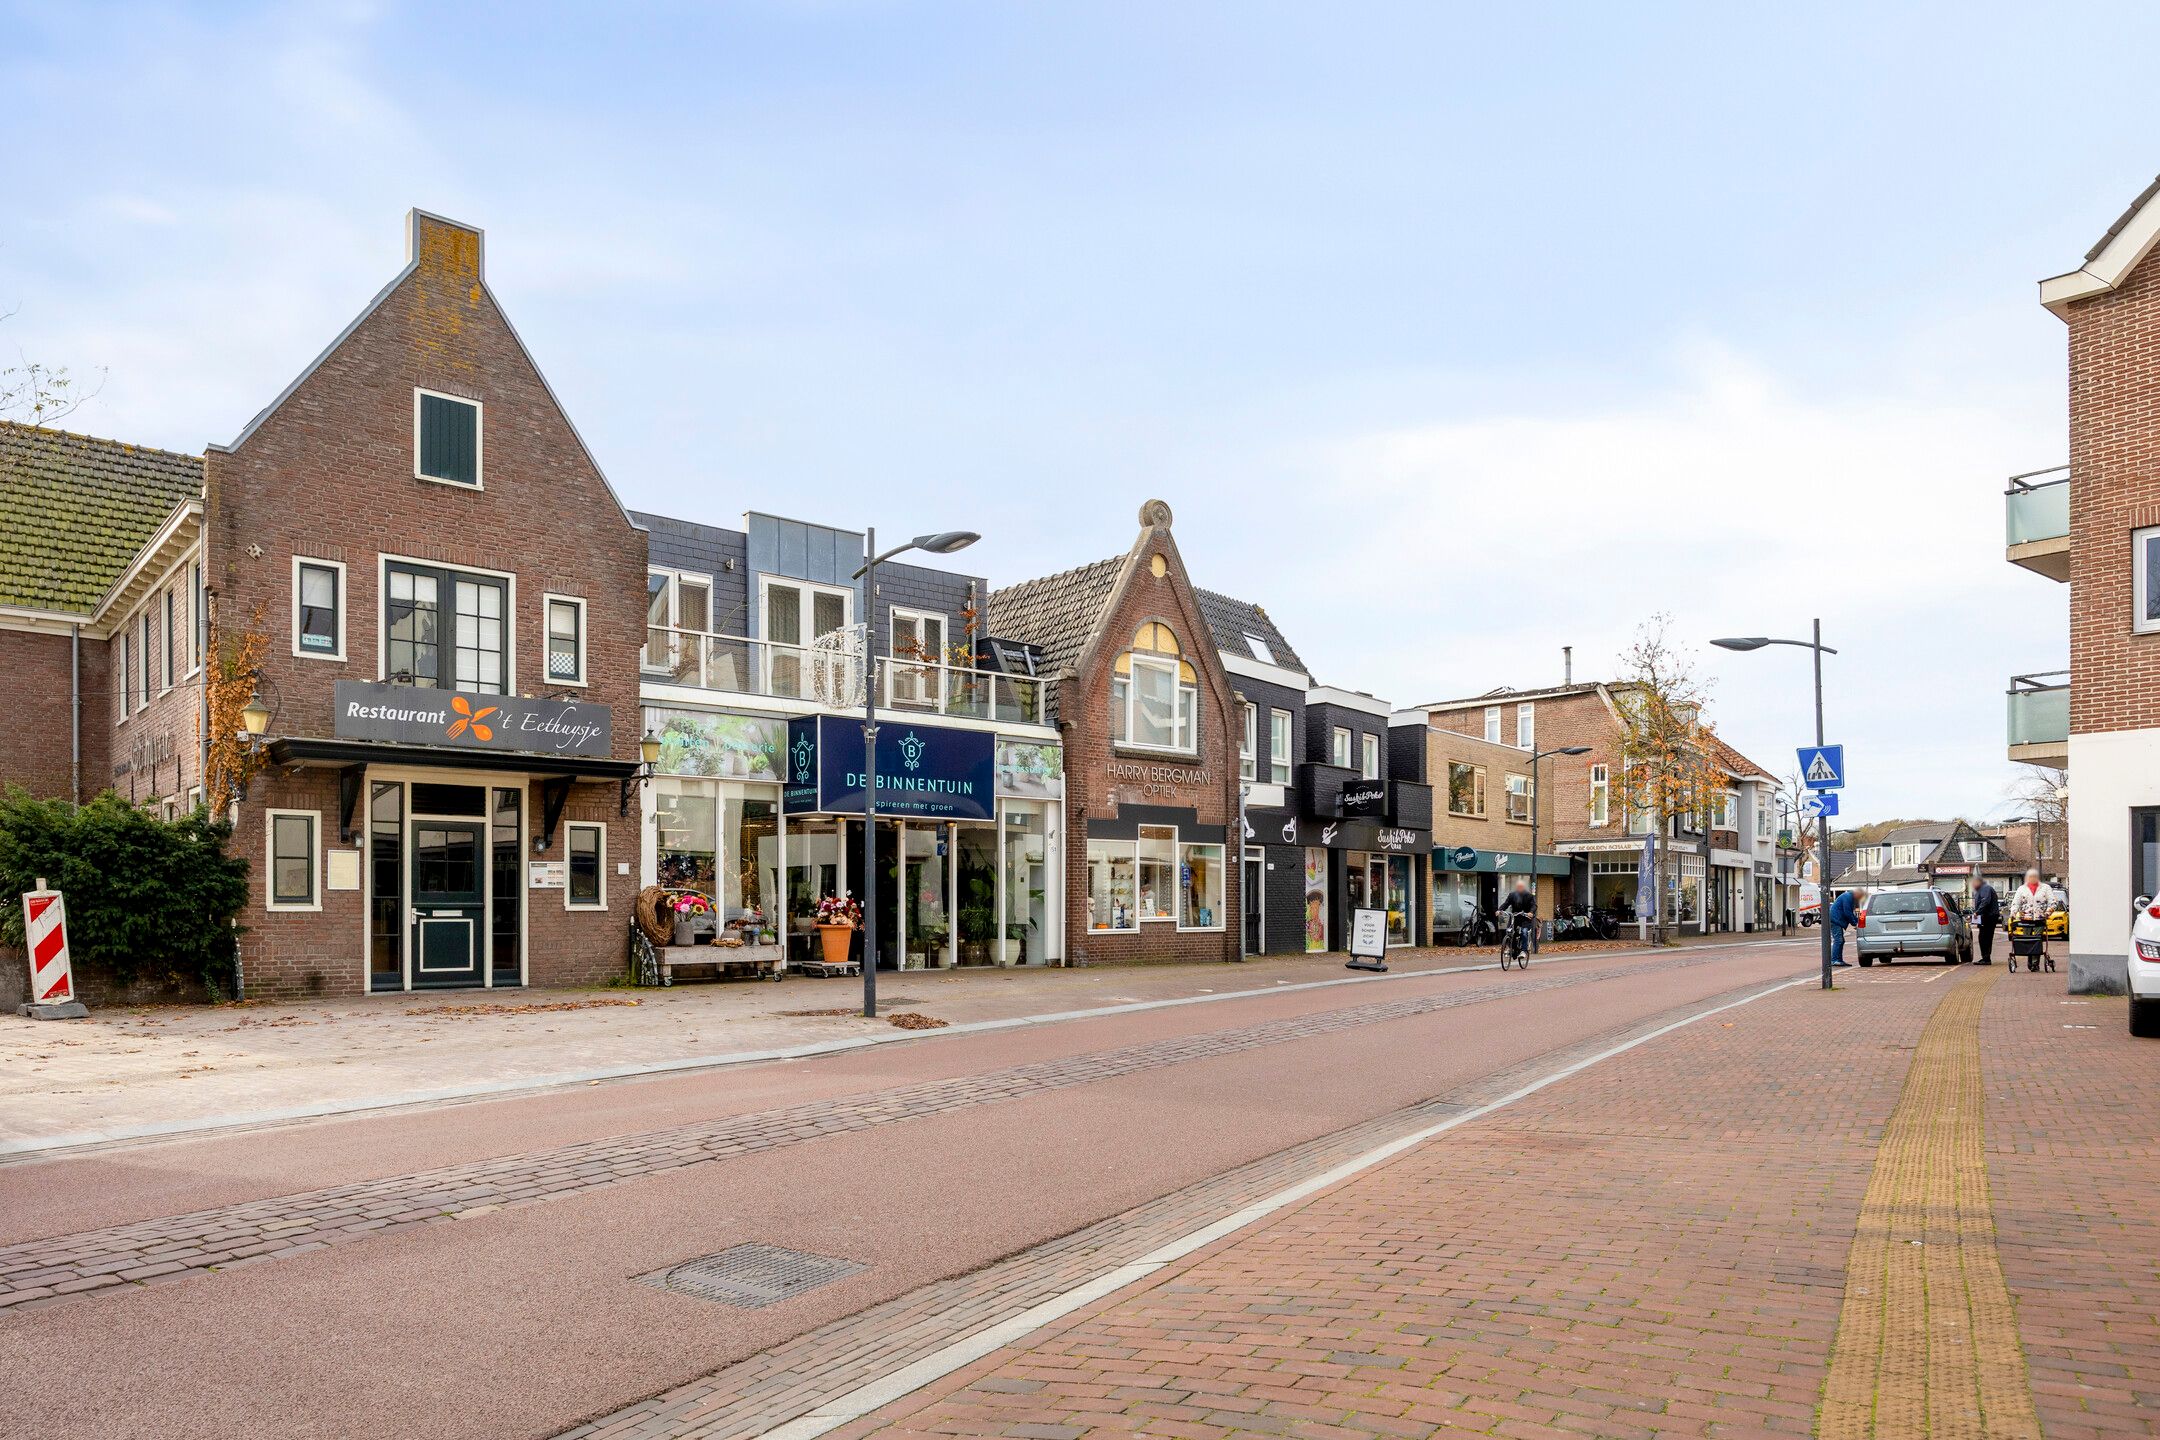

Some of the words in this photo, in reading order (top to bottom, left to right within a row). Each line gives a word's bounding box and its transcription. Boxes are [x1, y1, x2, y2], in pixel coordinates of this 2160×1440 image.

[347, 702, 447, 725] Restaurant
[520, 706, 603, 749] Eethuysje
[908, 744, 916, 758] B
[1106, 763, 1148, 781] HARRY
[1151, 767, 1211, 785] BERGMAN
[847, 773, 867, 788] DE
[876, 775, 973, 795] BINNENTUIN
[1143, 784, 1178, 798] OPTIEK
[875, 800, 912, 812] spireren
[913, 802, 928, 810] met
[931, 803, 954, 812] groen
